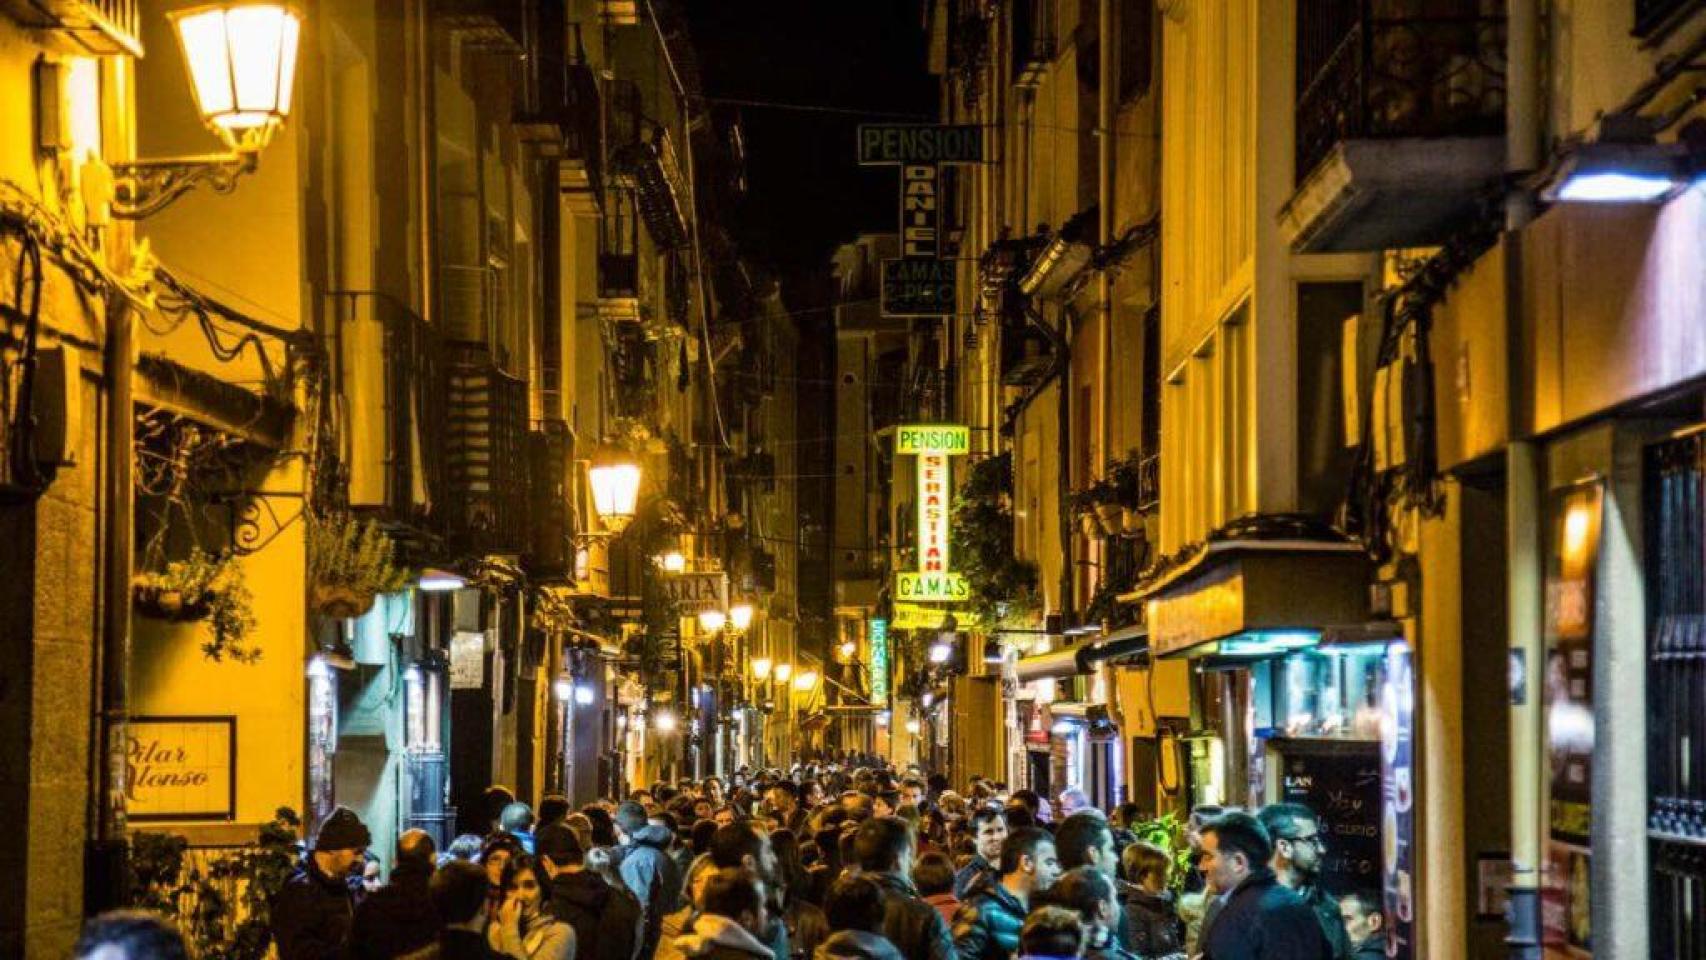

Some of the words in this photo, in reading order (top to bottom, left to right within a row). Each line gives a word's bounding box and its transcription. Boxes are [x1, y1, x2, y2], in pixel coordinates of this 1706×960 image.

[863, 128, 980, 159] PENSION
[905, 165, 936, 256] DANIEL
[900, 431, 966, 450] PENSION
[925, 456, 941, 571] SEBASTIAN
[900, 577, 966, 596] CAMAS
